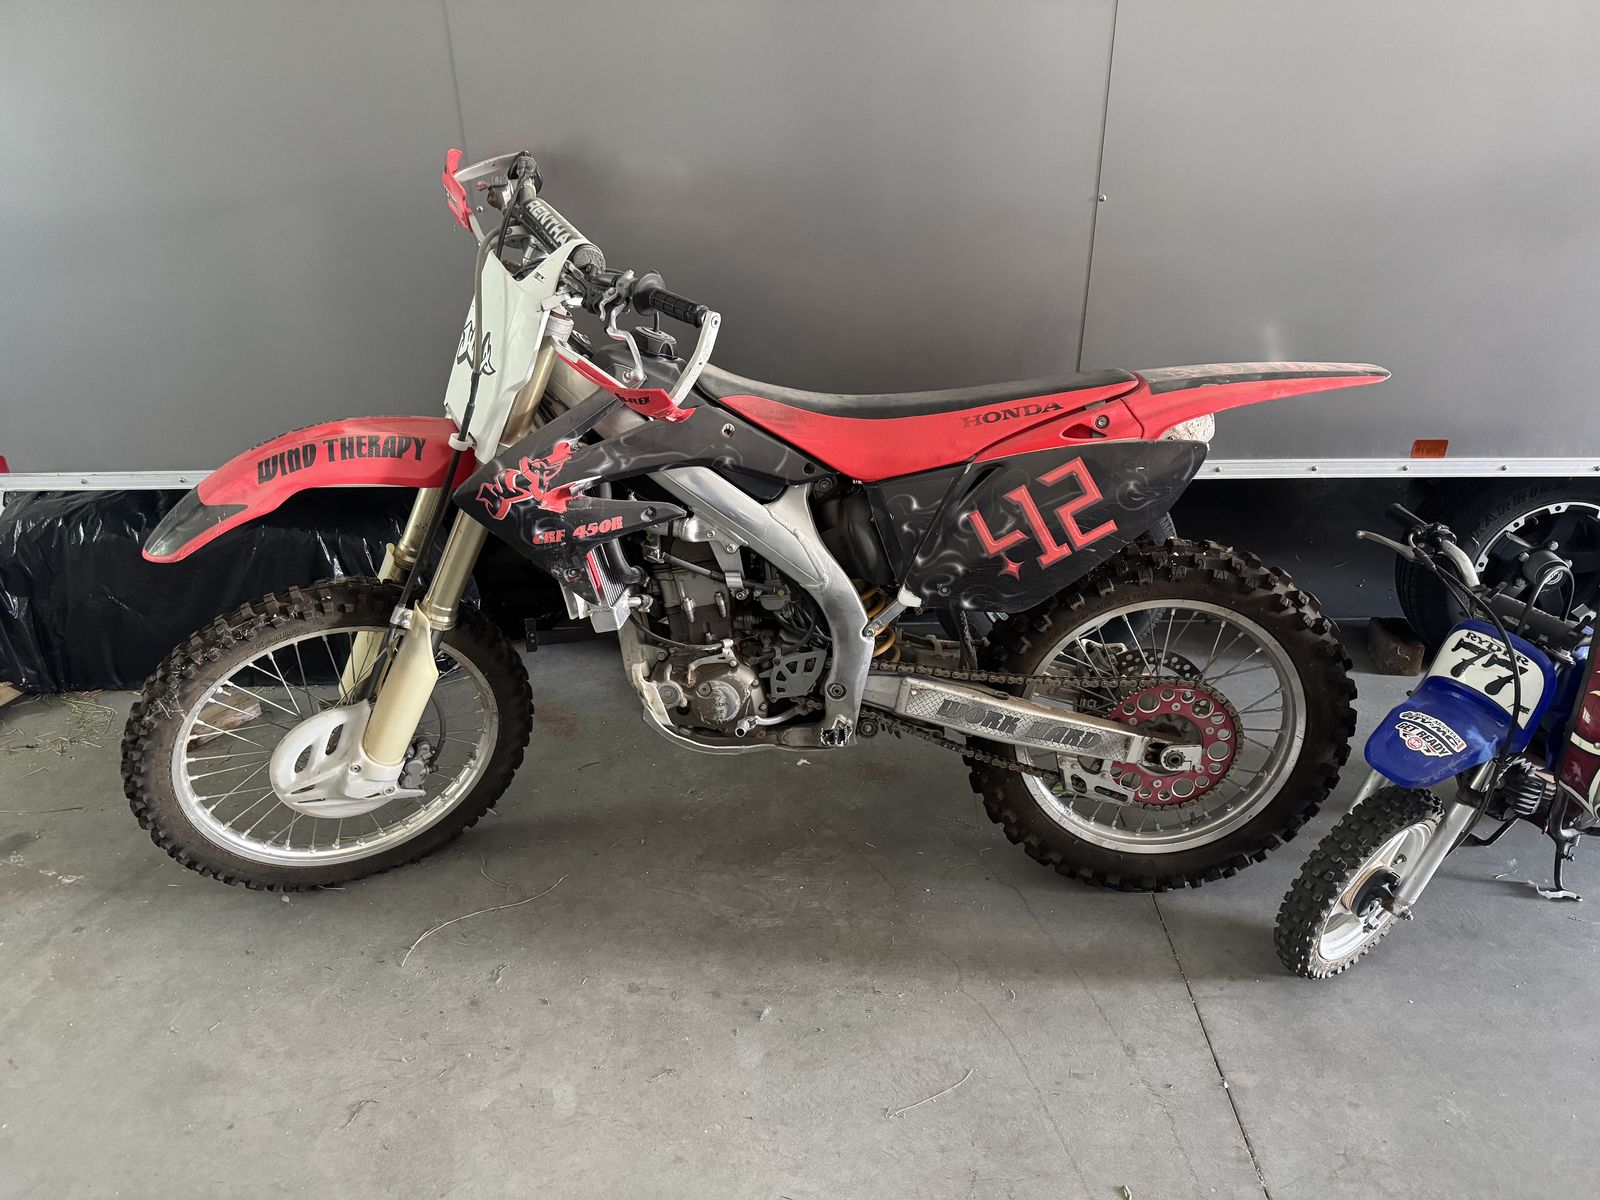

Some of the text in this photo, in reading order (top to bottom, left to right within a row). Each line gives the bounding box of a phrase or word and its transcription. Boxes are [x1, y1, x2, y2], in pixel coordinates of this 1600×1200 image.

[526, 200, 571, 246] RENTHA
[961, 402, 1065, 428] HONDA
[257, 435, 427, 485] WIND THERAPY
[532, 515, 624, 545] CRF 450R
[967, 456, 1119, 571] 412
[1450, 637, 1529, 696] 77
[936, 699, 1102, 749] WORK HARD
[1397, 722, 1419, 733] GET
[1416, 730, 1449, 755] READY
